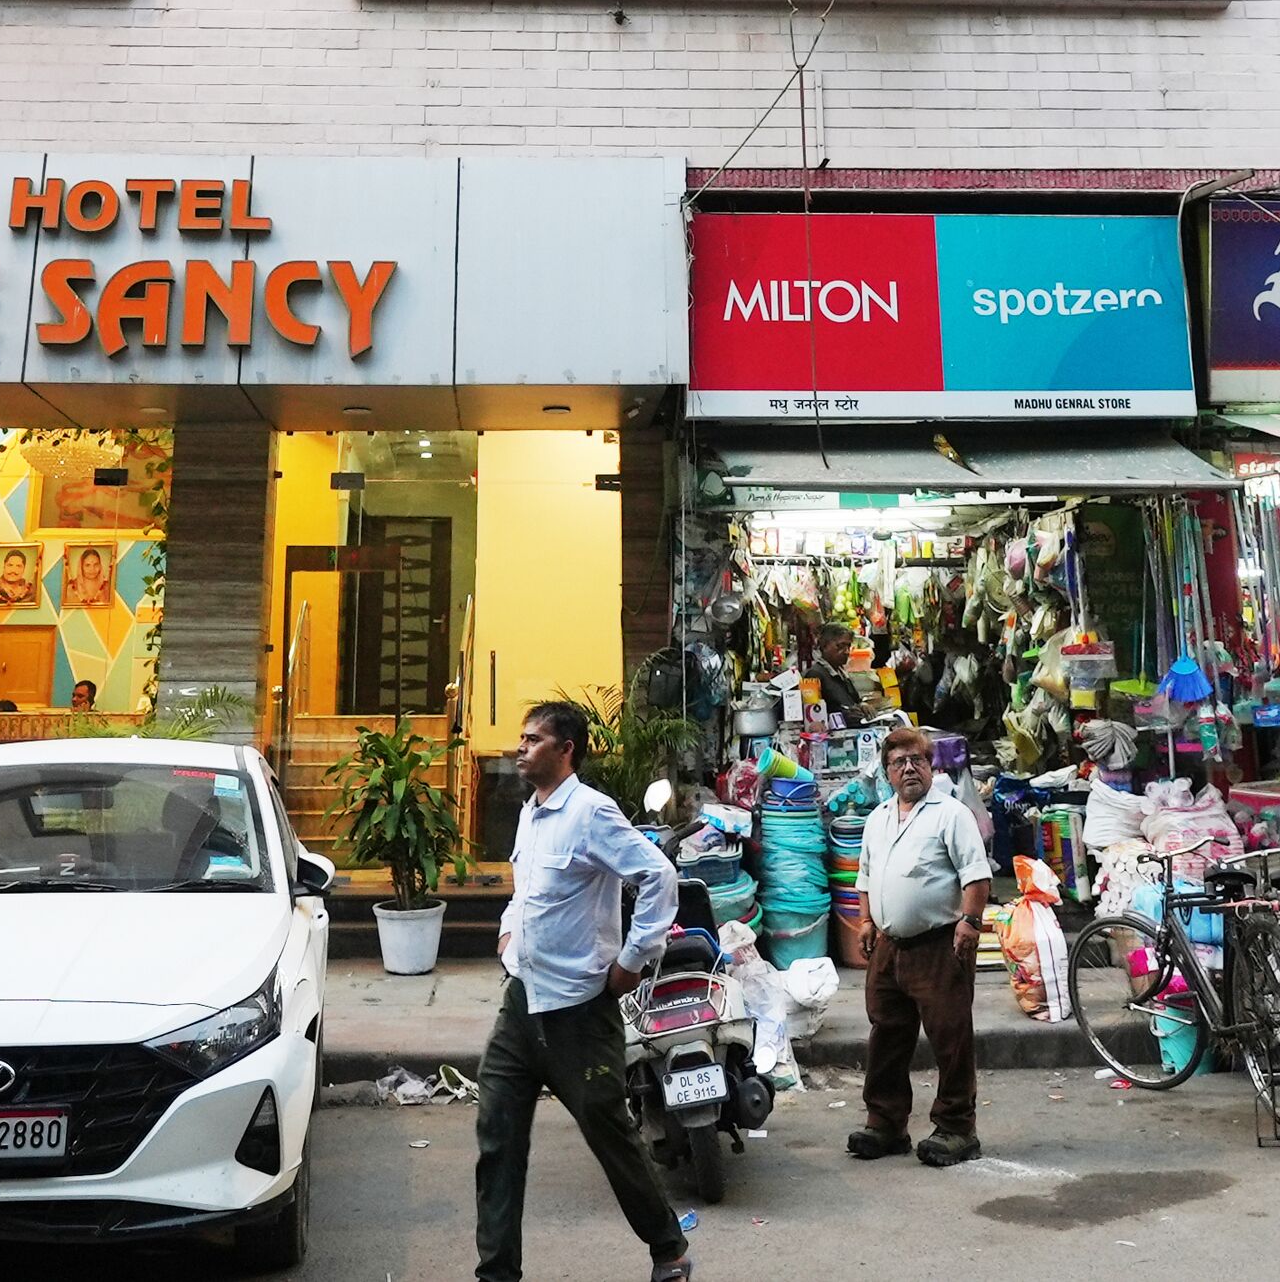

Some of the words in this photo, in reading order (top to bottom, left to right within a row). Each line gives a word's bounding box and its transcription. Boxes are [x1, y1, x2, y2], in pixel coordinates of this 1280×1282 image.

[8, 177, 272, 233] HOTEL
[36, 259, 398, 359] SANCY
[724, 279, 899, 323] MILTON
[973, 282, 1163, 324] spotzero
[769, 398, 788, 414] मधु
[793, 398, 829, 412] जनरल
[835, 396, 860, 412] स्टोर
[1014, 398, 1052, 410] MADHU
[1055, 397, 1095, 410] GENRAL
[1098, 397, 1131, 410] STORE
[677, 1091, 690, 1103] CE
[694, 1085, 717, 1100] 9115
[680, 1075, 693, 1088] DL
[697, 1071, 710, 1084] 8S
